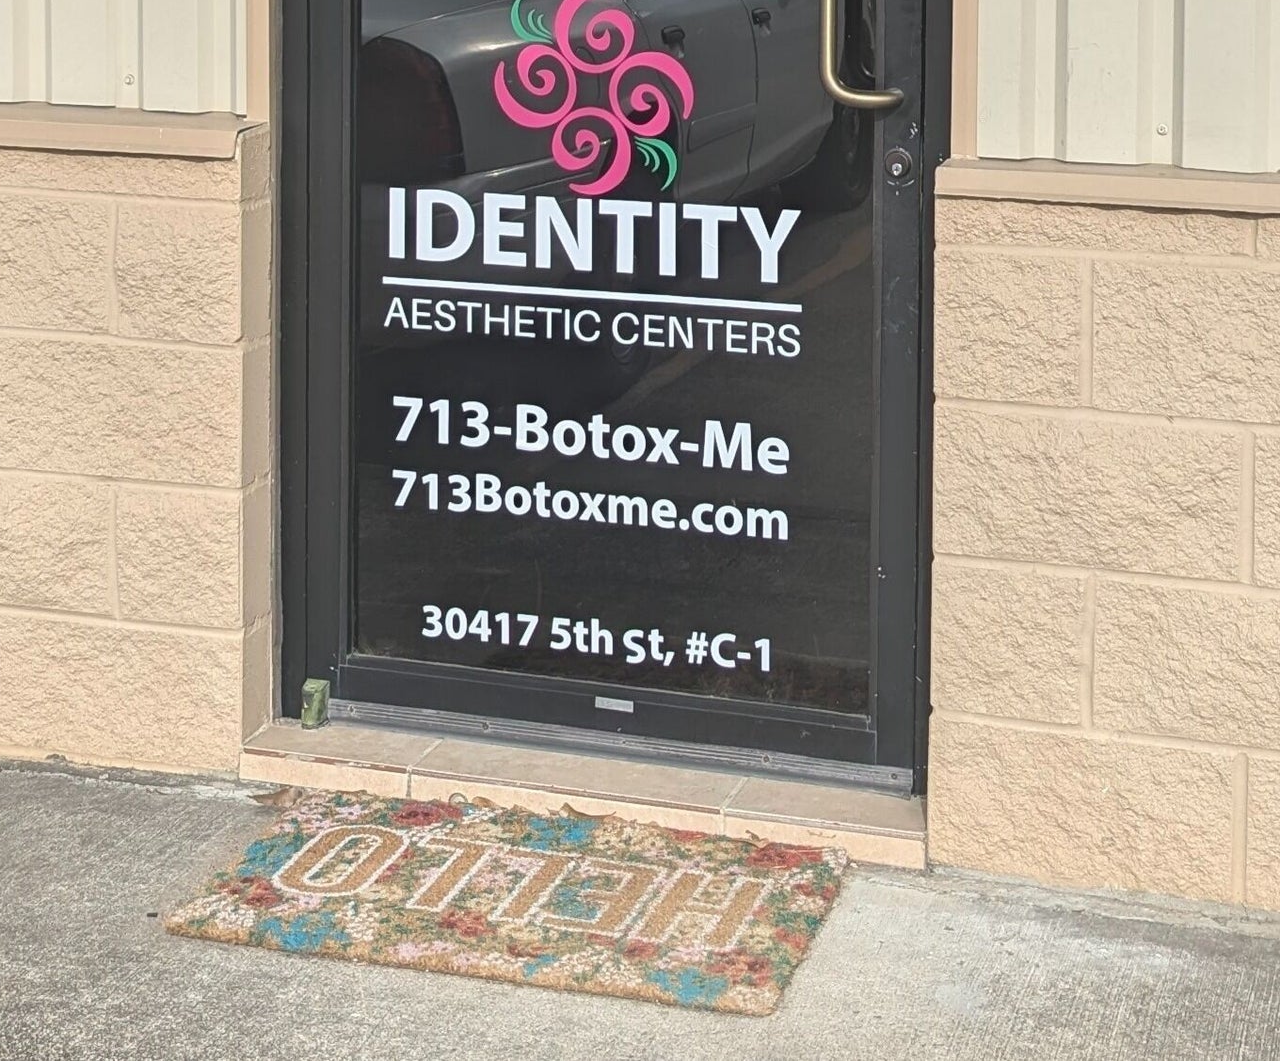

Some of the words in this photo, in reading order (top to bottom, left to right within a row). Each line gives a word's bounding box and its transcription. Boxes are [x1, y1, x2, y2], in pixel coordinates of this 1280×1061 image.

[388, 187, 802, 284] IDENTITY
[383, 296, 602, 342] AESTHETIC
[611, 311, 803, 358] CENTERS
[392, 395, 790, 475] 713-Botox-Me
[392, 469, 789, 541] 713Botoxme.com
[421, 604, 539, 647] 30417
[549, 617, 614, 656] 5th
[622, 628, 675, 667] St,
[685, 631, 770, 672] #C-1
[270, 822, 768, 951] HELLO
